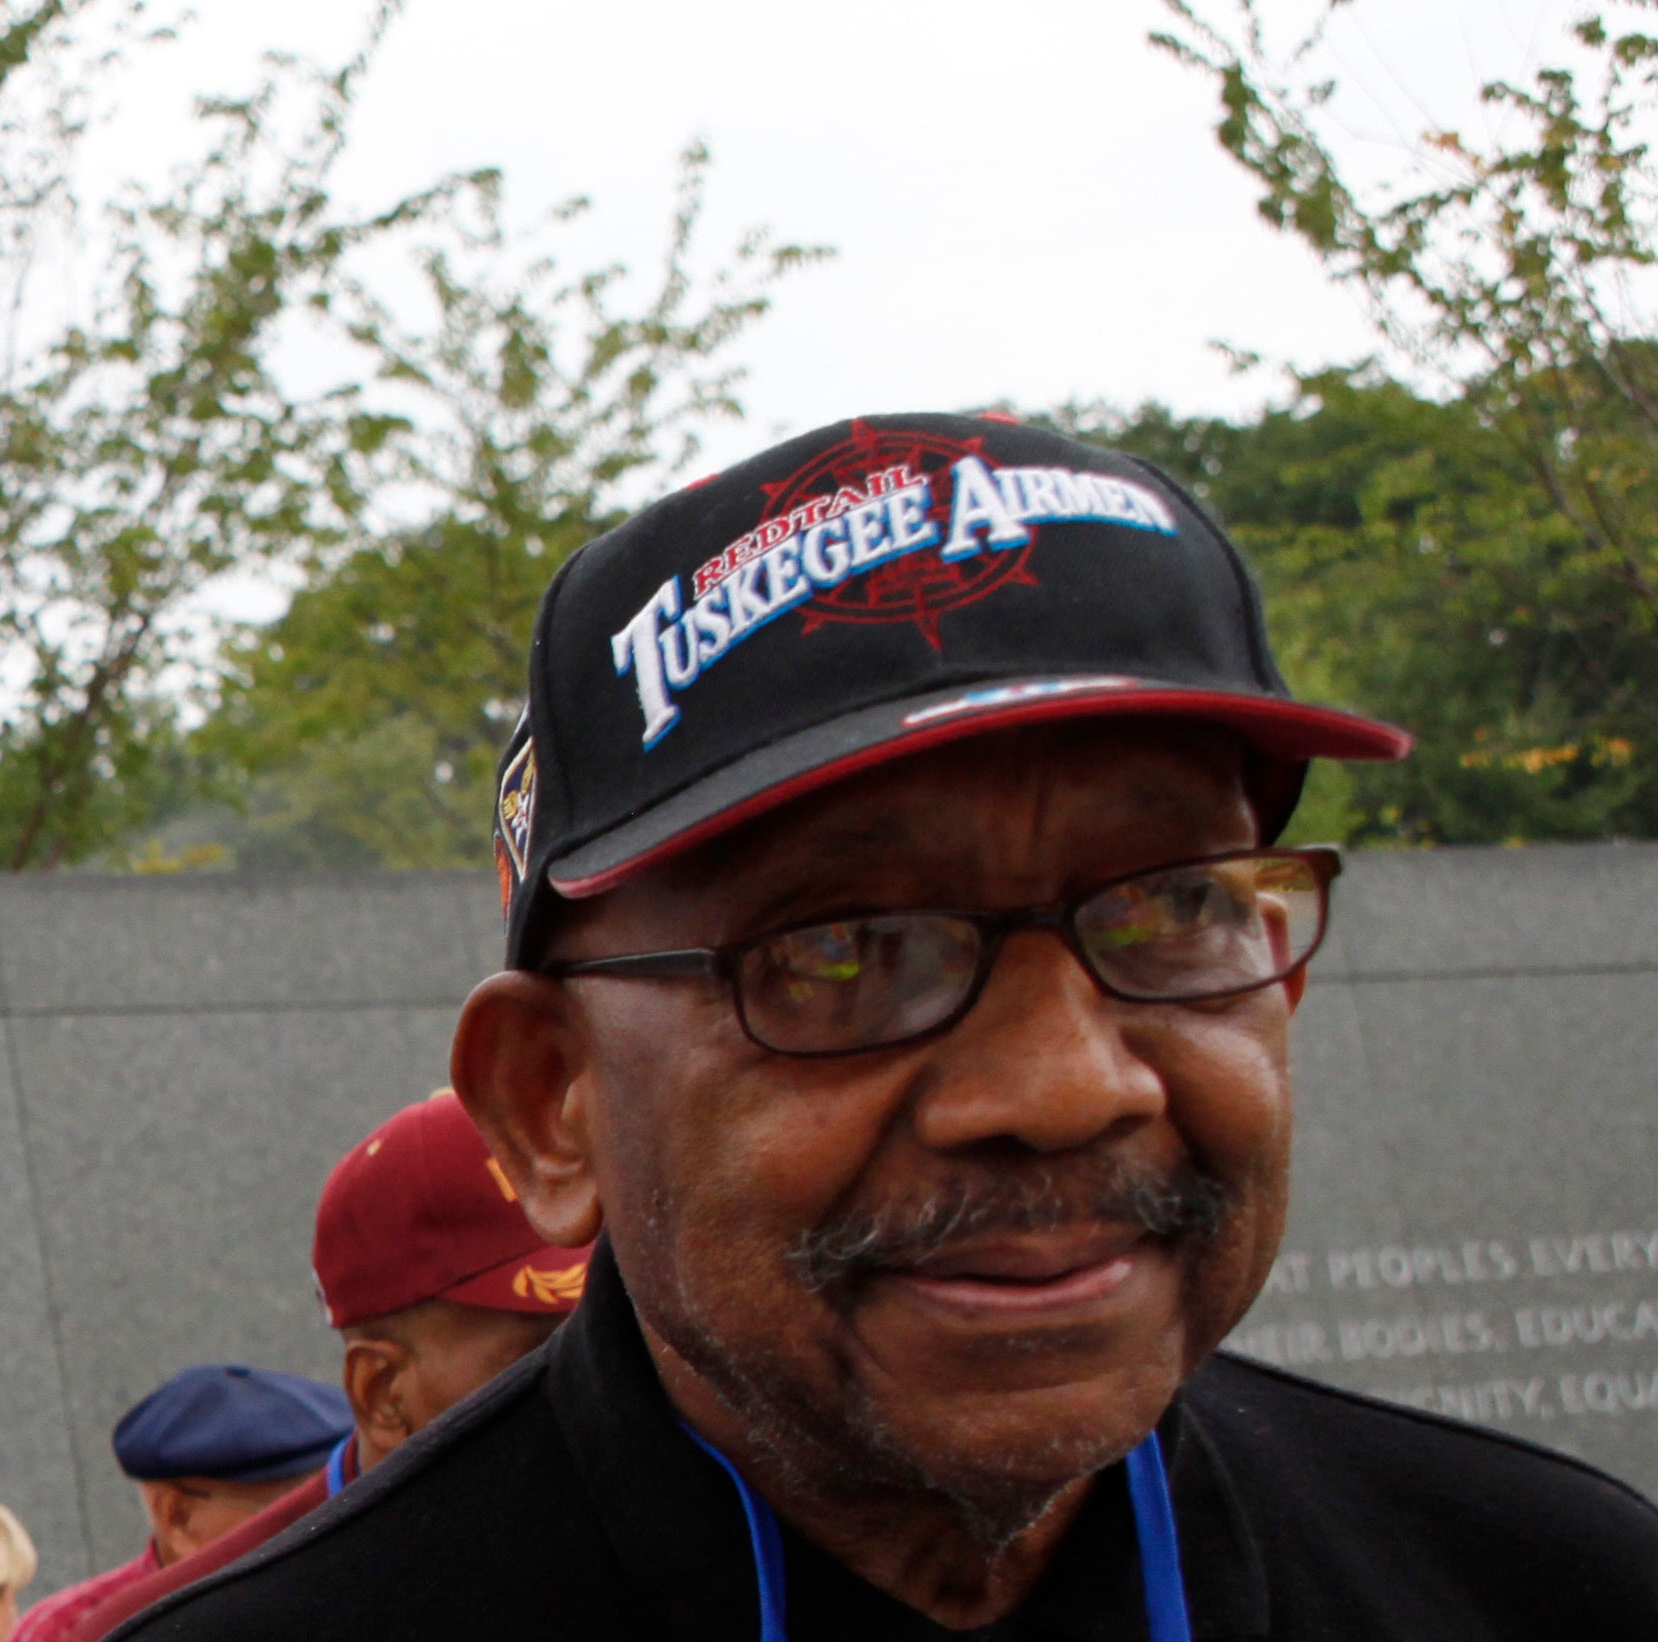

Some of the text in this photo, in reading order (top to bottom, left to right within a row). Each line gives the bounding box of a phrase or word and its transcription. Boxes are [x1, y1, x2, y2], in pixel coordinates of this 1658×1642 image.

[692, 463, 930, 596] REDTAIL
[612, 454, 1178, 752] TUSKEGEE AIRMEN
[1327, 1237, 1518, 1291] PEOPLES
